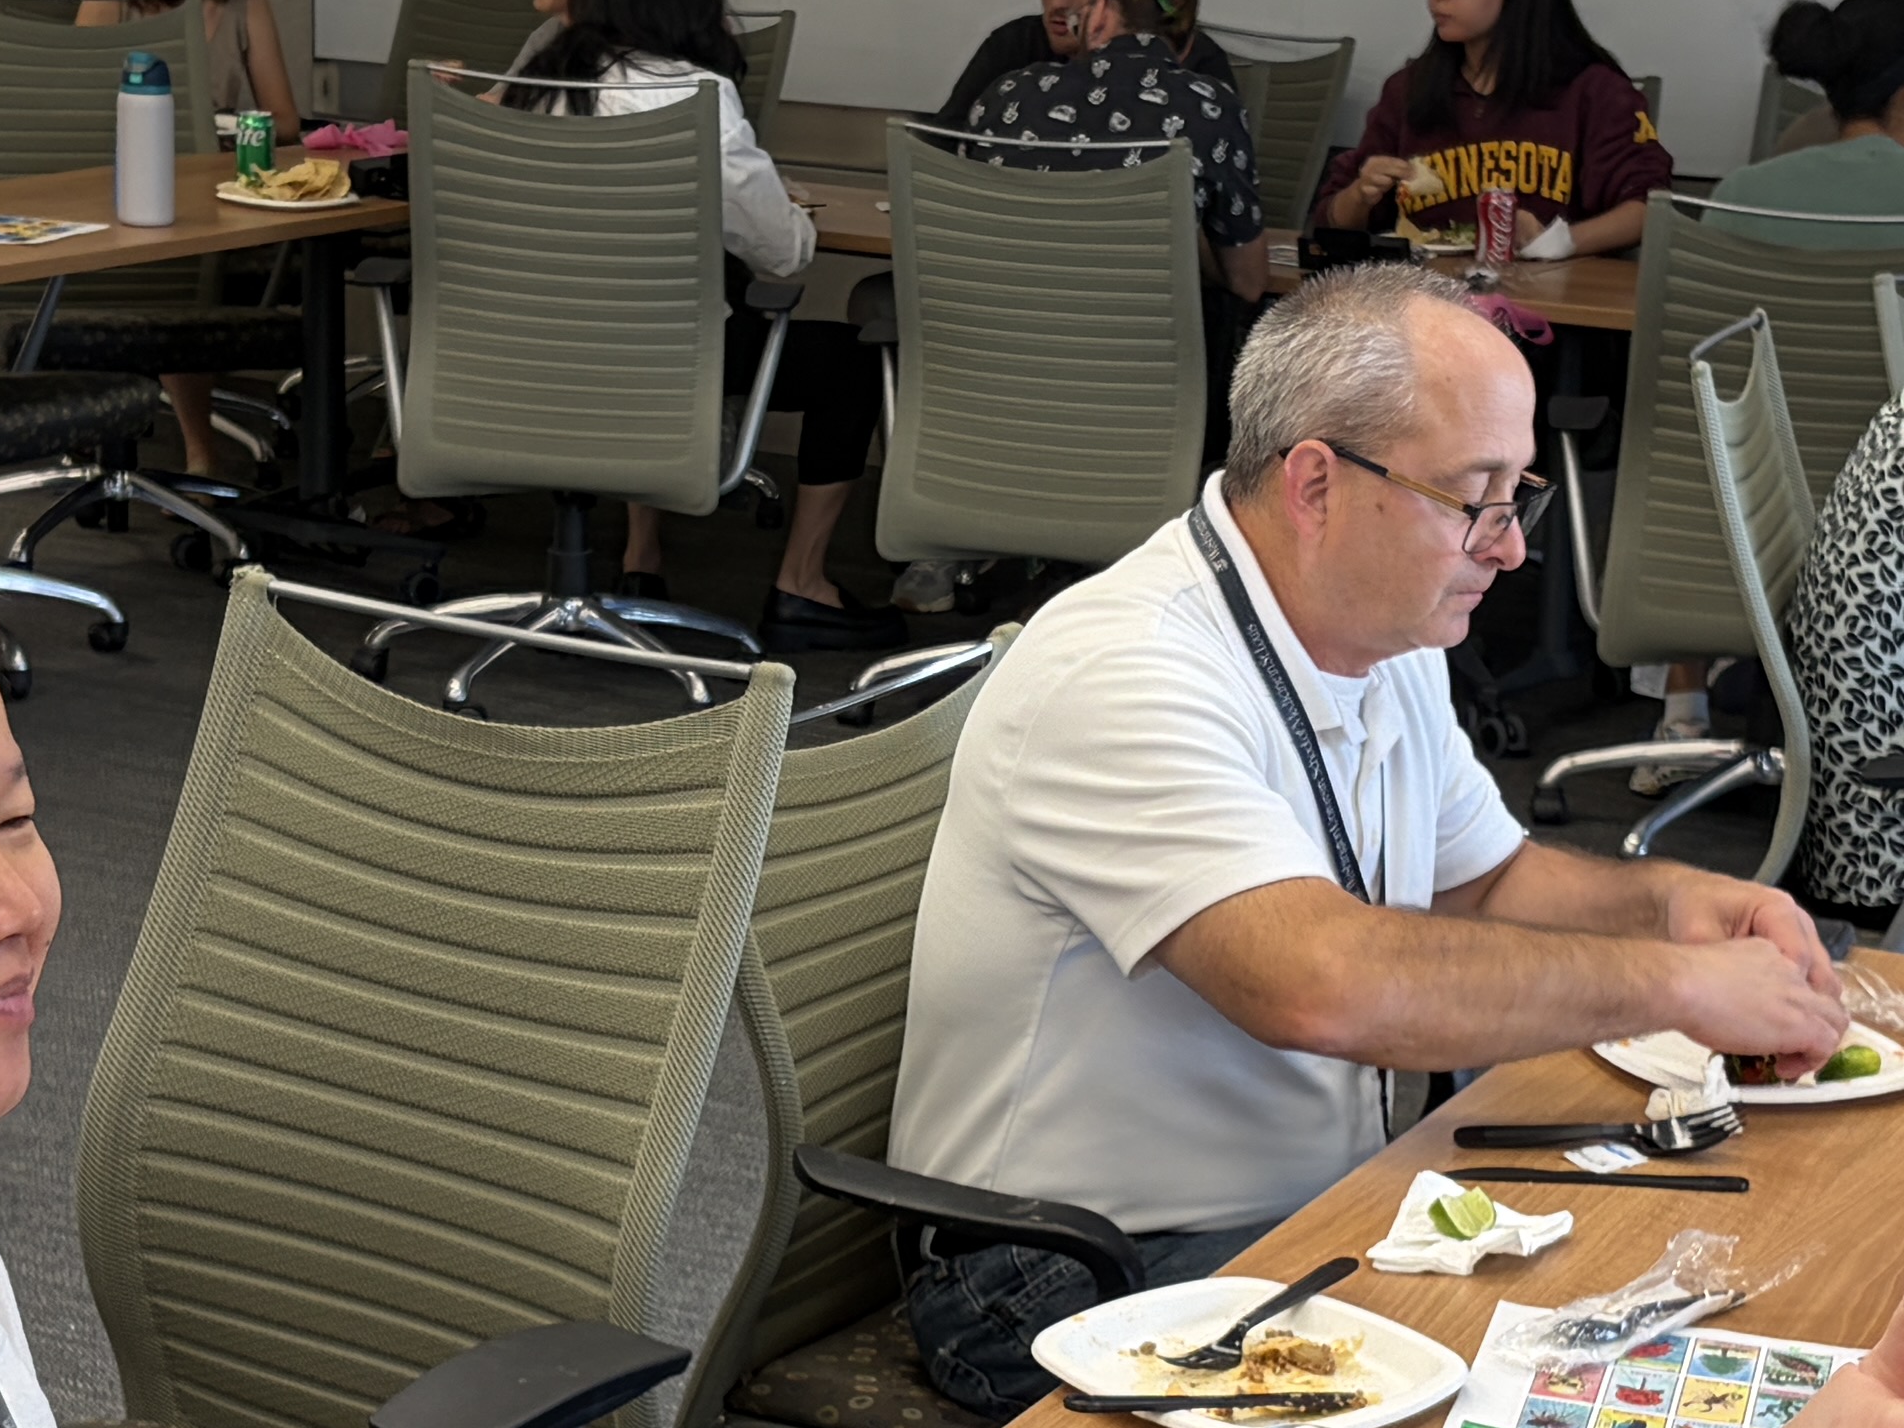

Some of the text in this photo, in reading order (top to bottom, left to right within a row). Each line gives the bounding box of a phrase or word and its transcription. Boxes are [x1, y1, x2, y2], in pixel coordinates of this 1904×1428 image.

[236, 125, 266, 147] ite
[1404, 139, 1573, 213] NNESOTA
[1247, 623, 1267, 656] Louis
[1273, 681, 1304, 732] Medicine
[1299, 745, 1323, 781] School
